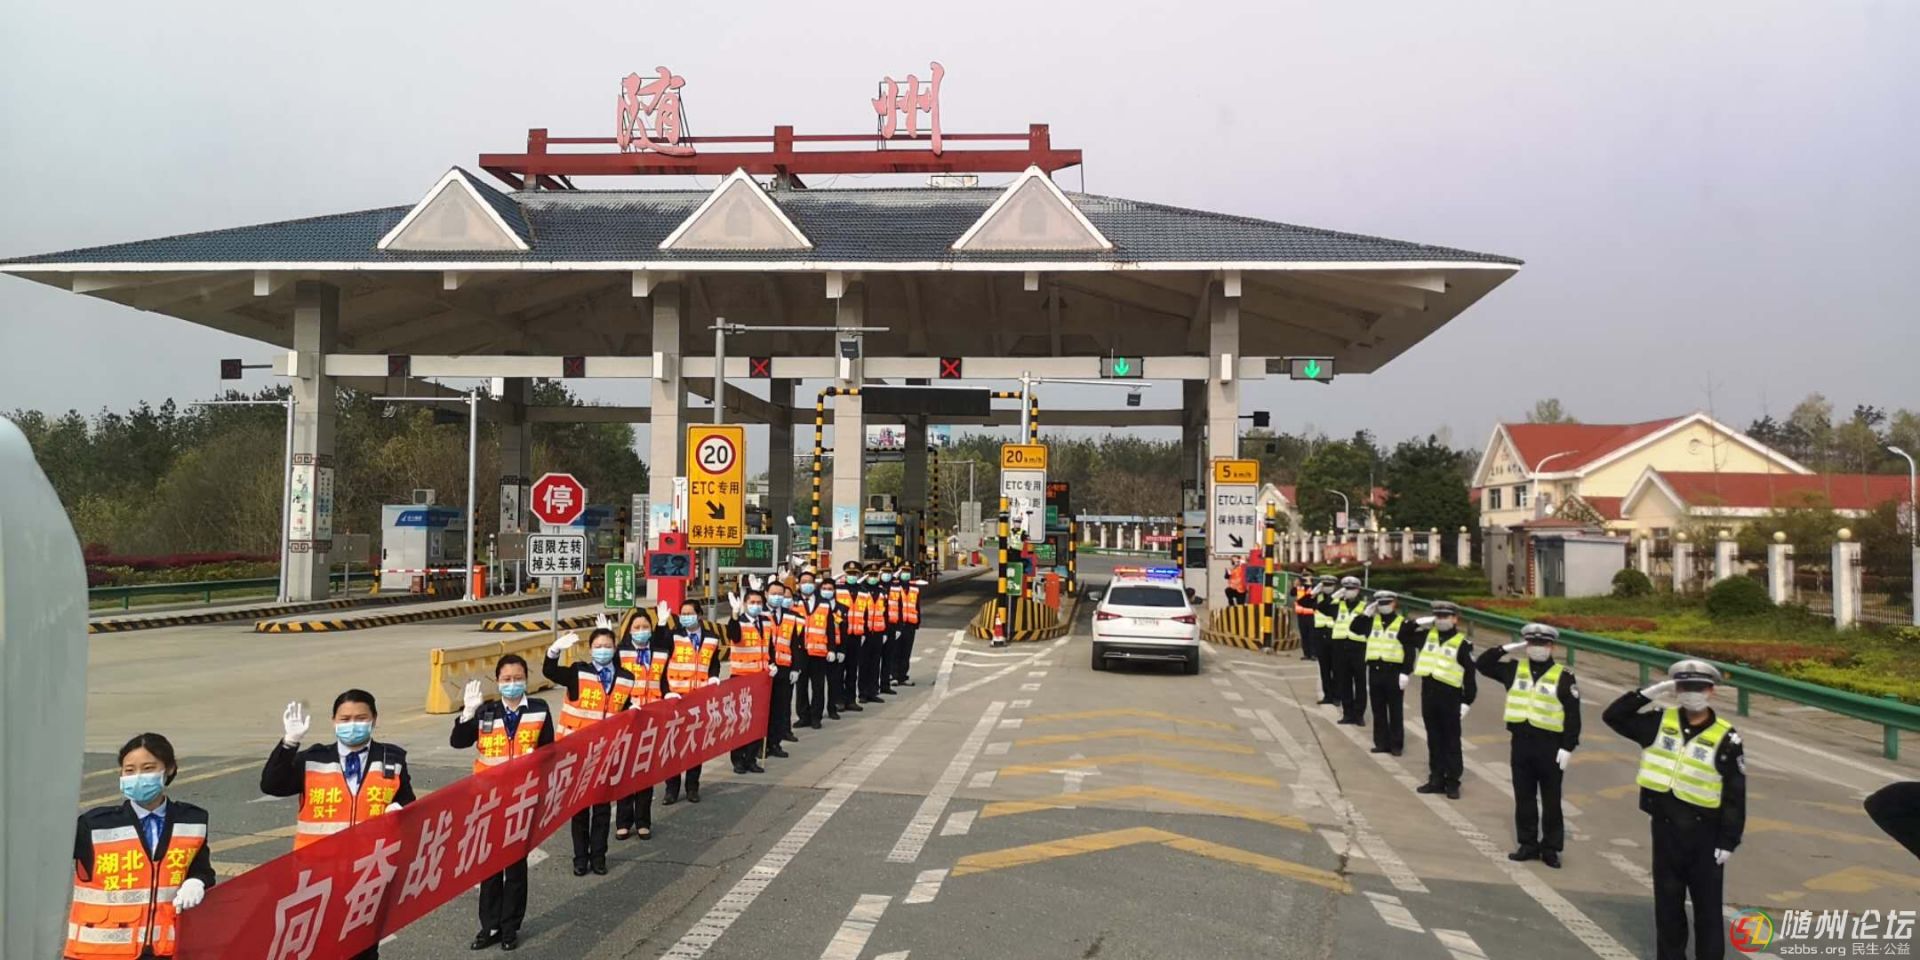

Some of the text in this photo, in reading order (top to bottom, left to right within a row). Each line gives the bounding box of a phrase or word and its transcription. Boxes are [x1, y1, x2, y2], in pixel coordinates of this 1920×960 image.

[617, 61, 945, 157] 随州
[704, 445, 729, 464] 20
[1006, 450, 1023, 463] 20
[1222, 465, 1231, 478] 5
[692, 481, 739, 494] ETC 专用
[1005, 481, 1023, 490] ETC
[1024, 481, 1041, 491] 专用
[543, 484, 573, 514] 停
[1218, 515, 1254, 526] 保持车距
[692, 525, 738, 539] 保持车距
[532, 539, 581, 554] 超限左转
[532, 557, 581, 571] 掉头车辆
[309, 787, 343, 804] 湖北
[313, 805, 337, 818] 汉十
[96, 849, 144, 874] 湖北
[104, 873, 138, 891] 汉十
